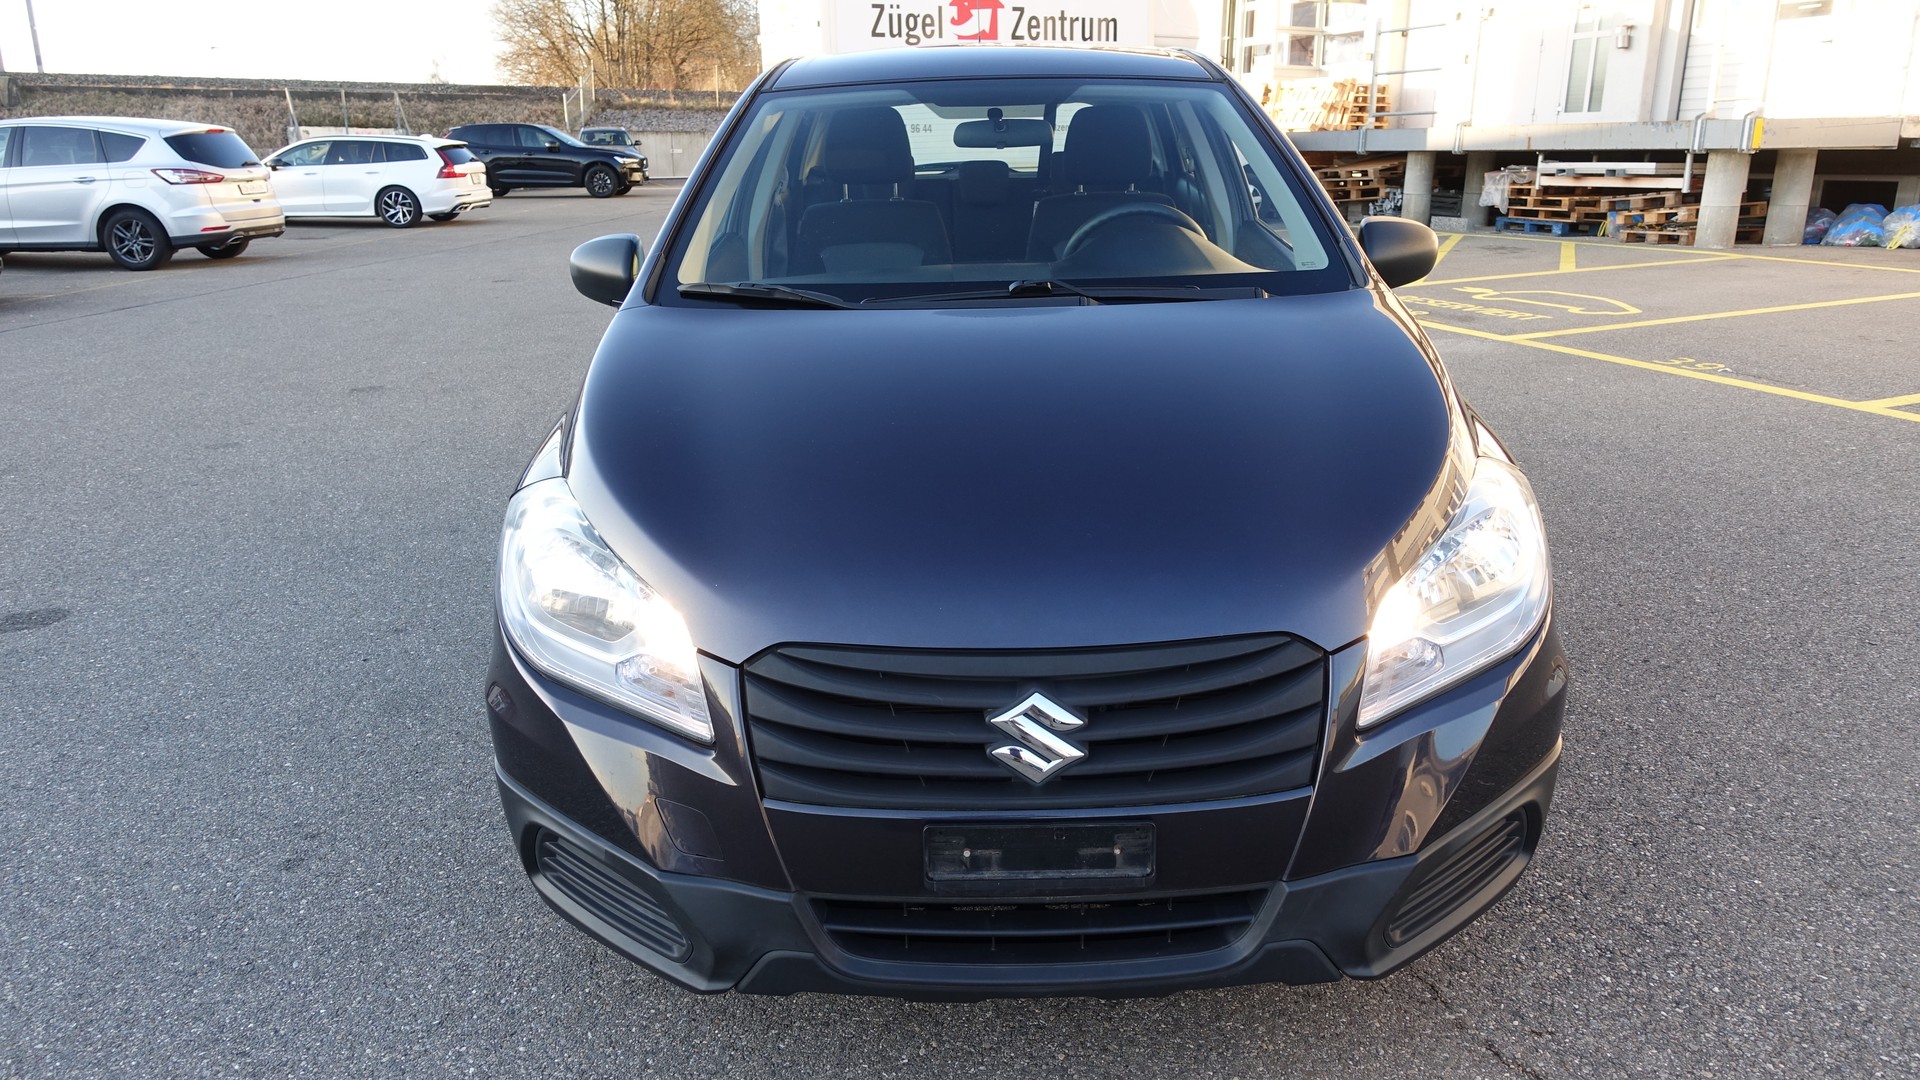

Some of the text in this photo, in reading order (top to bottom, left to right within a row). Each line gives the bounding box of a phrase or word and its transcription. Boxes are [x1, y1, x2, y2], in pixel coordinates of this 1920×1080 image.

[871, 3, 1118, 46] Zügel Zentrum
[910, 123, 933, 134] 96 44
